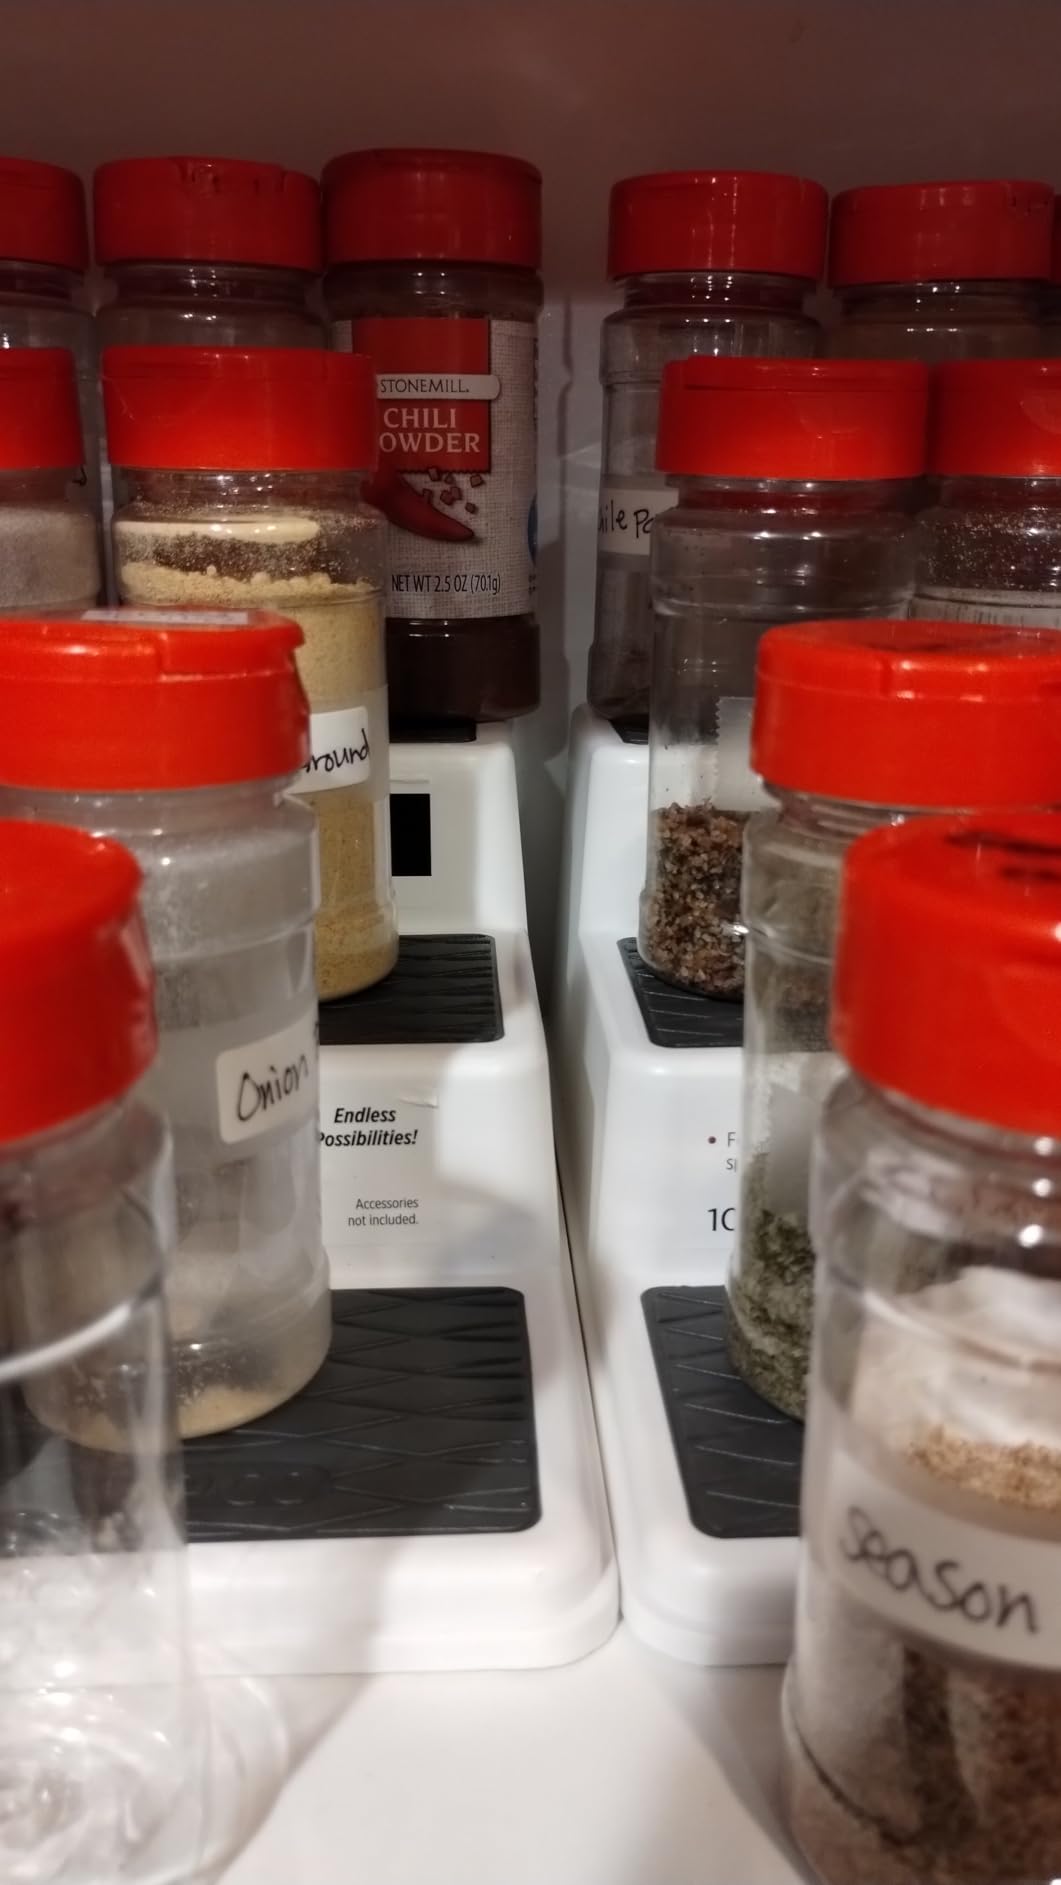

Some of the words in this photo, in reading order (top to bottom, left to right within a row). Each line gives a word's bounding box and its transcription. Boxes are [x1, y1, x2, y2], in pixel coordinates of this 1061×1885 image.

[383, 407, 457, 429] CHILI
[379, 432, 481, 453] OWDER
[391, 574, 410, 593] NET
[413, 574, 432, 593] WT
[434, 574, 451, 593] 2.5
[453, 574, 468, 593] OZ
[470, 573, 501, 595] (70.1g)
[302, 727, 370, 774] round
[236, 1053, 309, 1122] Onion
[333, 1106, 397, 1124] Endless
[355, 1198, 420, 1210] Accessories
[347, 1215, 367, 1227] not
[369, 1213, 420, 1226] included.
